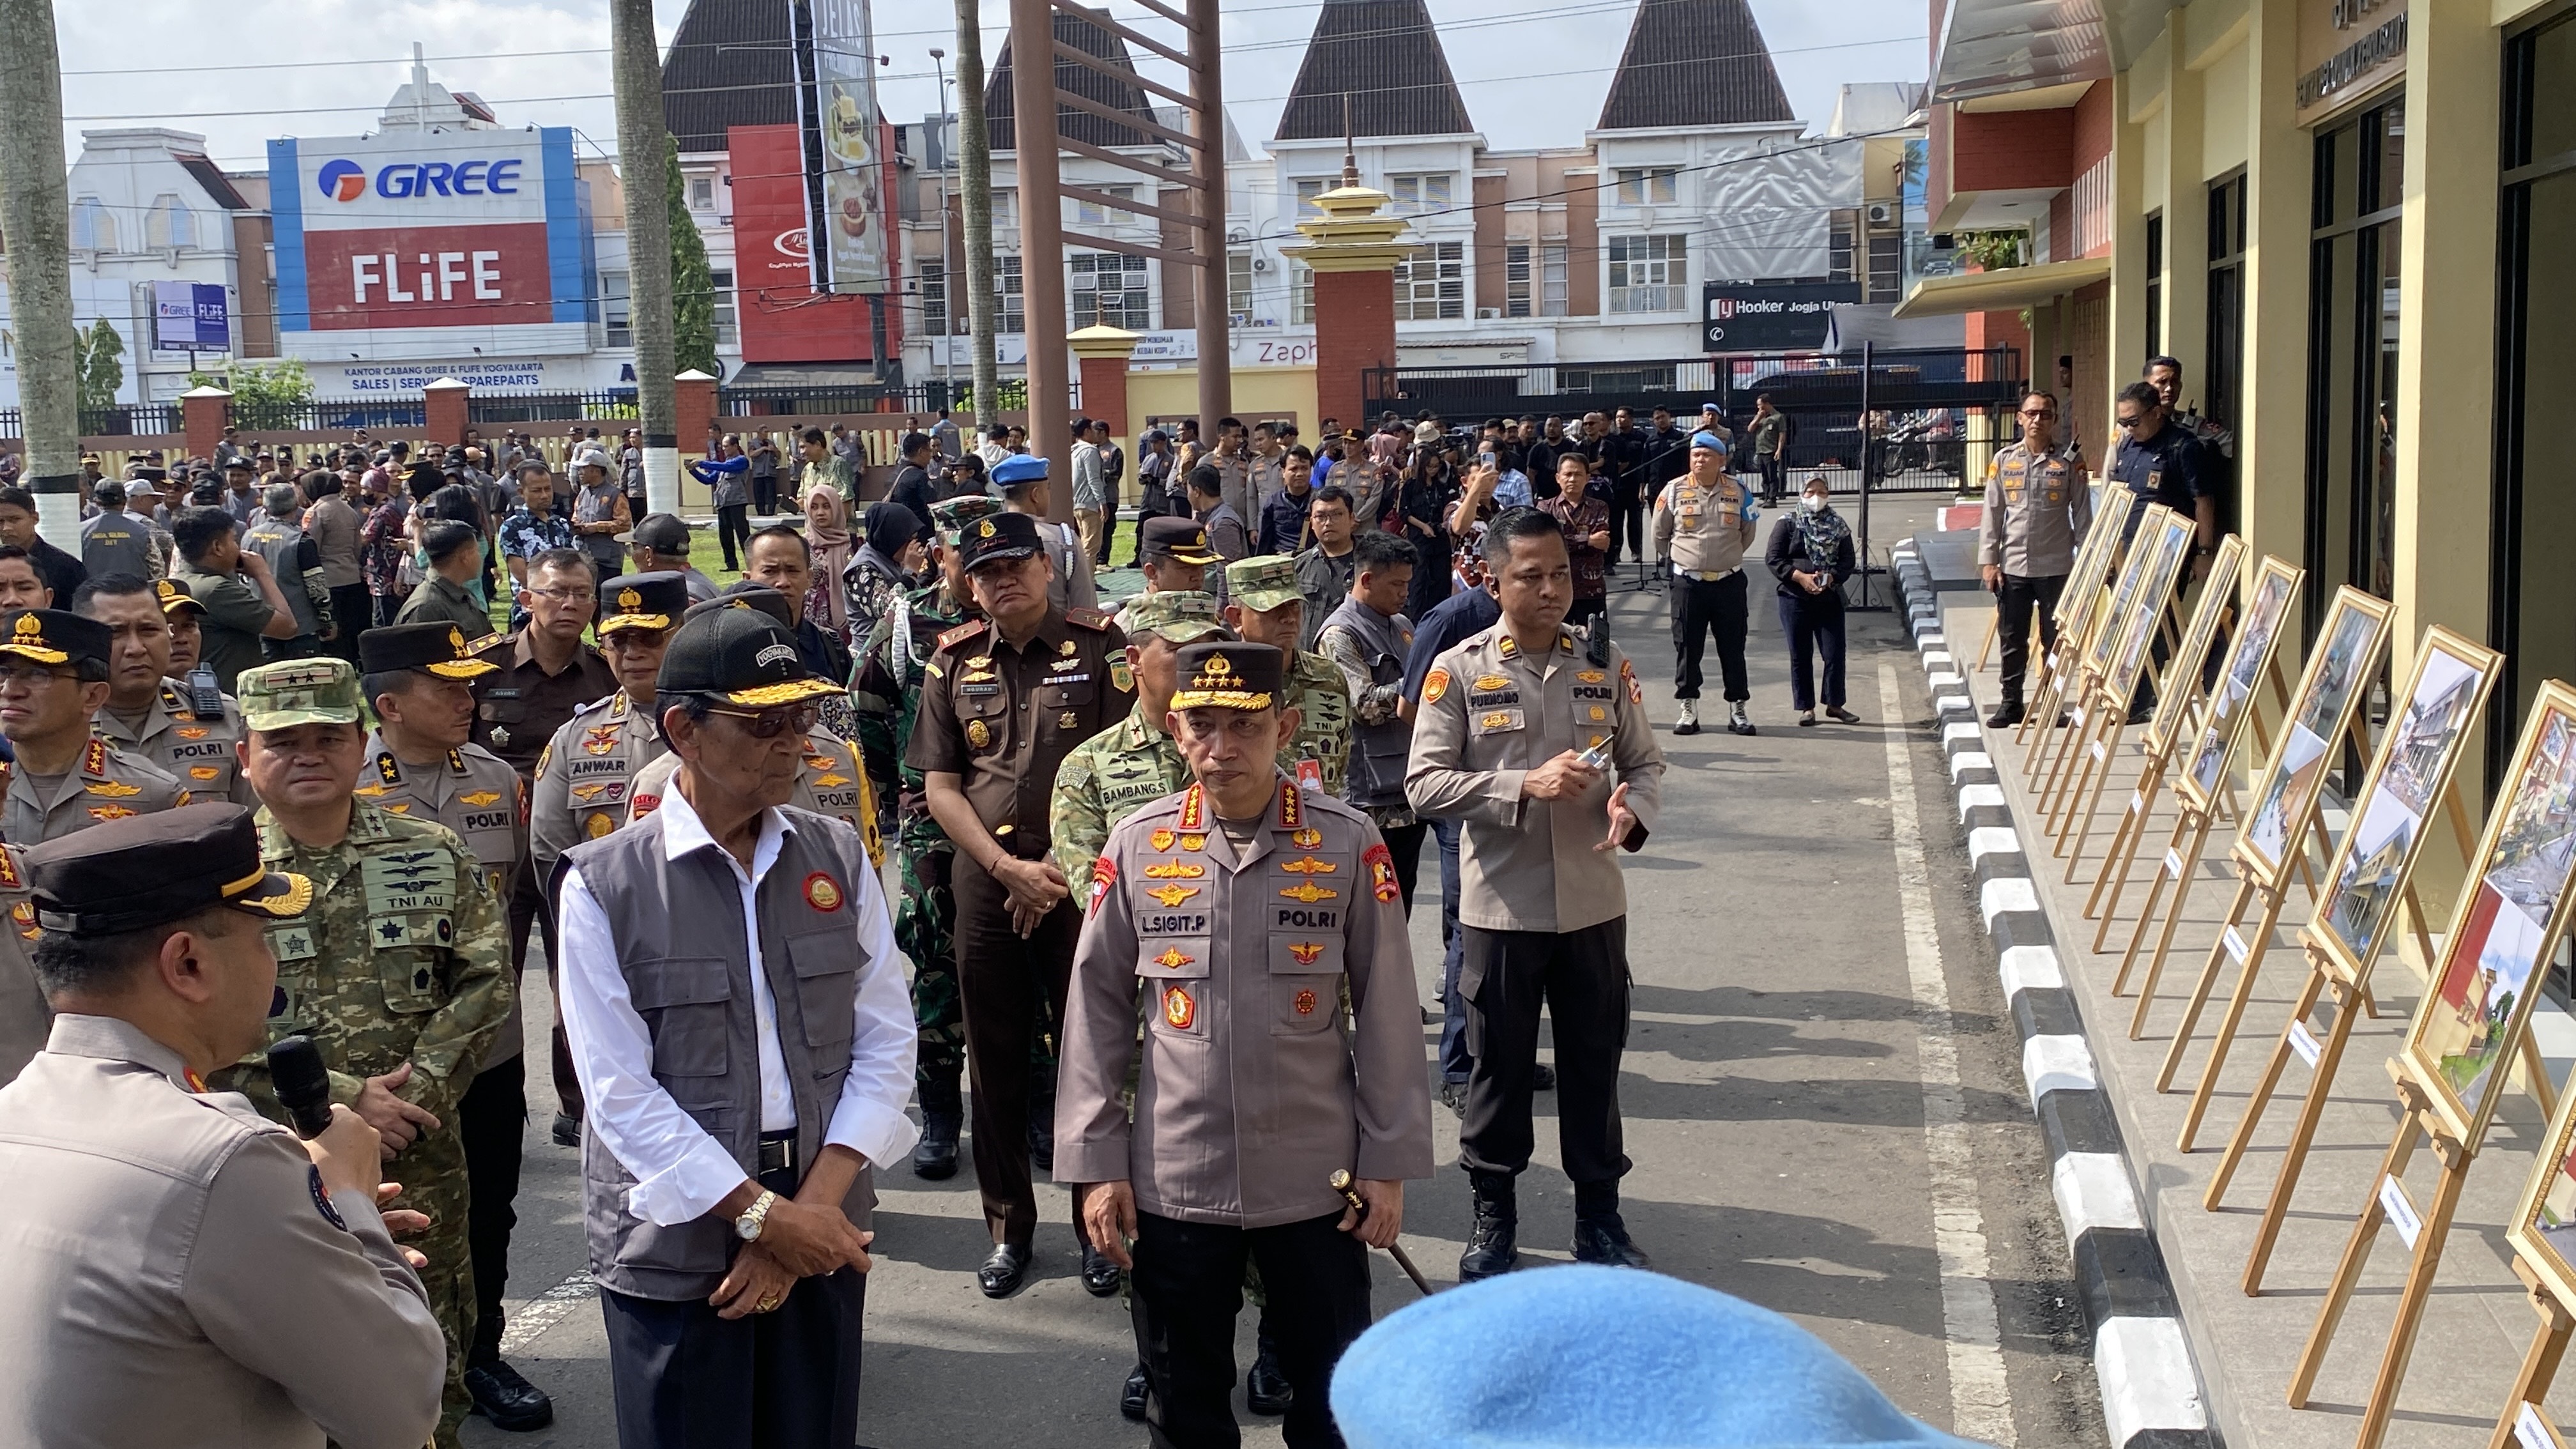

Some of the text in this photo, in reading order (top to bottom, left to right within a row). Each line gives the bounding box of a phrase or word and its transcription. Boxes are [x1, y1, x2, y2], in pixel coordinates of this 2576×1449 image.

[376, 158, 522, 199] GREE
[169, 305, 191, 316] GREE
[1736, 299, 1784, 314] Hooker
[1788, 302, 1820, 314] Jogja
[344, 367, 381, 376] KANTOR
[383, 366, 422, 375] CABANG
[424, 365, 447, 374] GREE
[450, 365, 456, 373] &
[484, 363, 544, 372] YOGYAKARTA
[352, 378, 390, 390] SALES
[461, 374, 539, 387] SPAREPARTS
[1573, 687, 1613, 700] POLRI
[1314, 722, 1332, 730] TNI
[173, 743, 223, 759] POLRI
[572, 760, 625, 775] ANWAR
[818, 792, 859, 807] POLRI
[1103, 783, 1167, 805] BAMBANG.S
[466, 813, 509, 830] POLRI
[387, 896, 443, 908] TNI AU
[1142, 915, 1205, 933] L.SIGIT.P
[1278, 910, 1337, 928] POLRI
